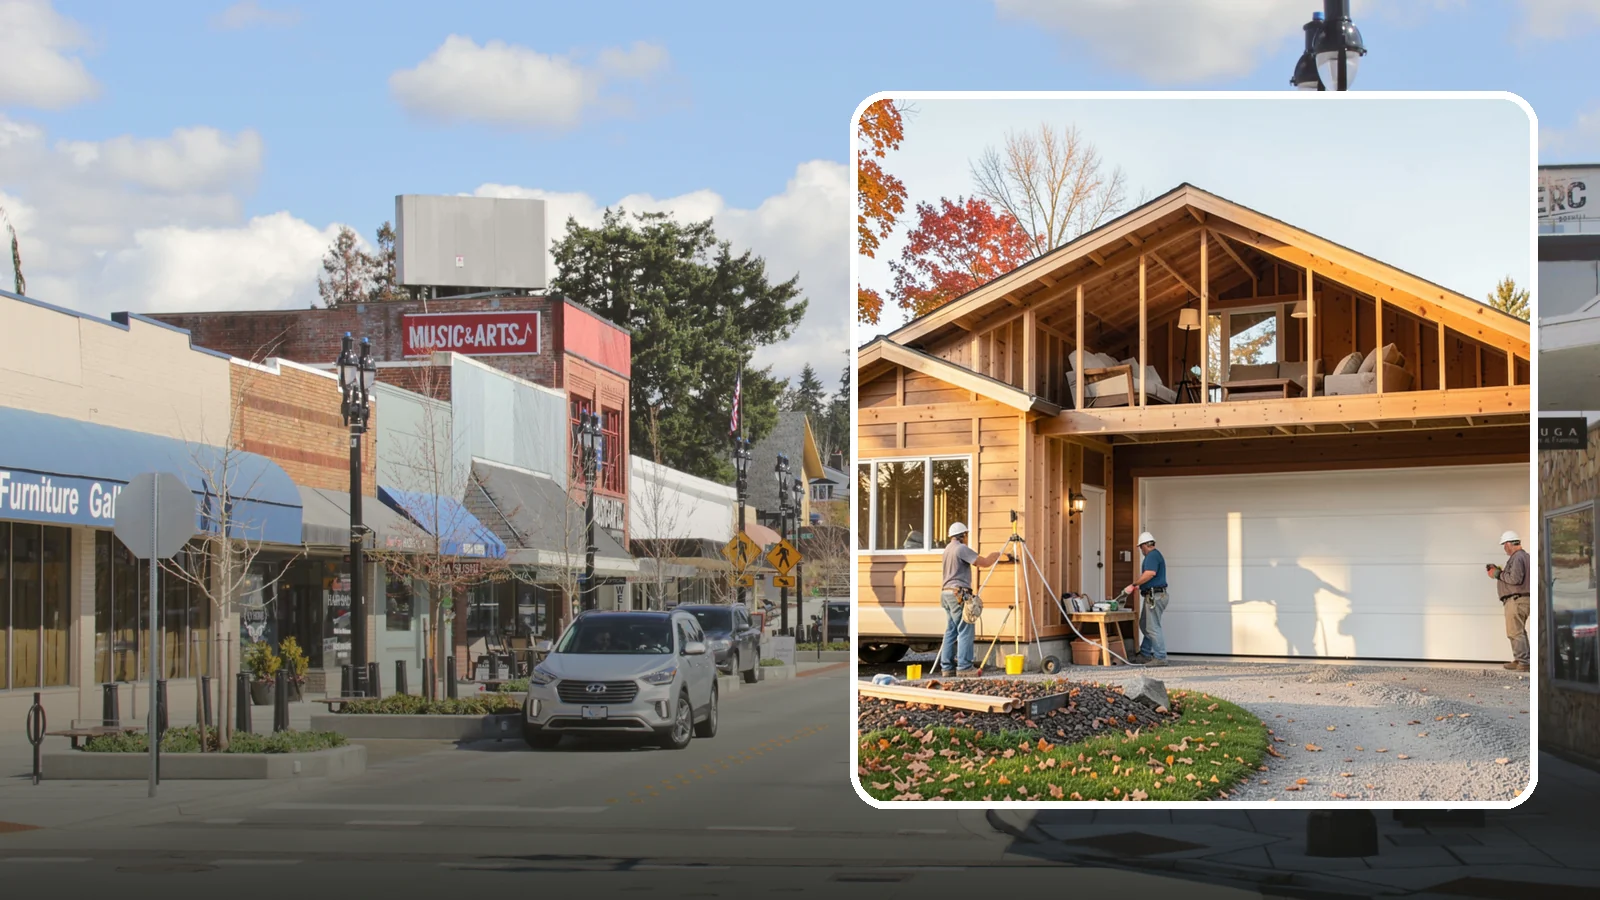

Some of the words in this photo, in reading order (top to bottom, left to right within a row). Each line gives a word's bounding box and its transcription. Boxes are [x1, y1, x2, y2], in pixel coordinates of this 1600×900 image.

[409, 323, 519, 348] MUSIC&ARTS
[1540, 428, 1577, 436] UGA
[0, 471, 79, 515] Furniture
